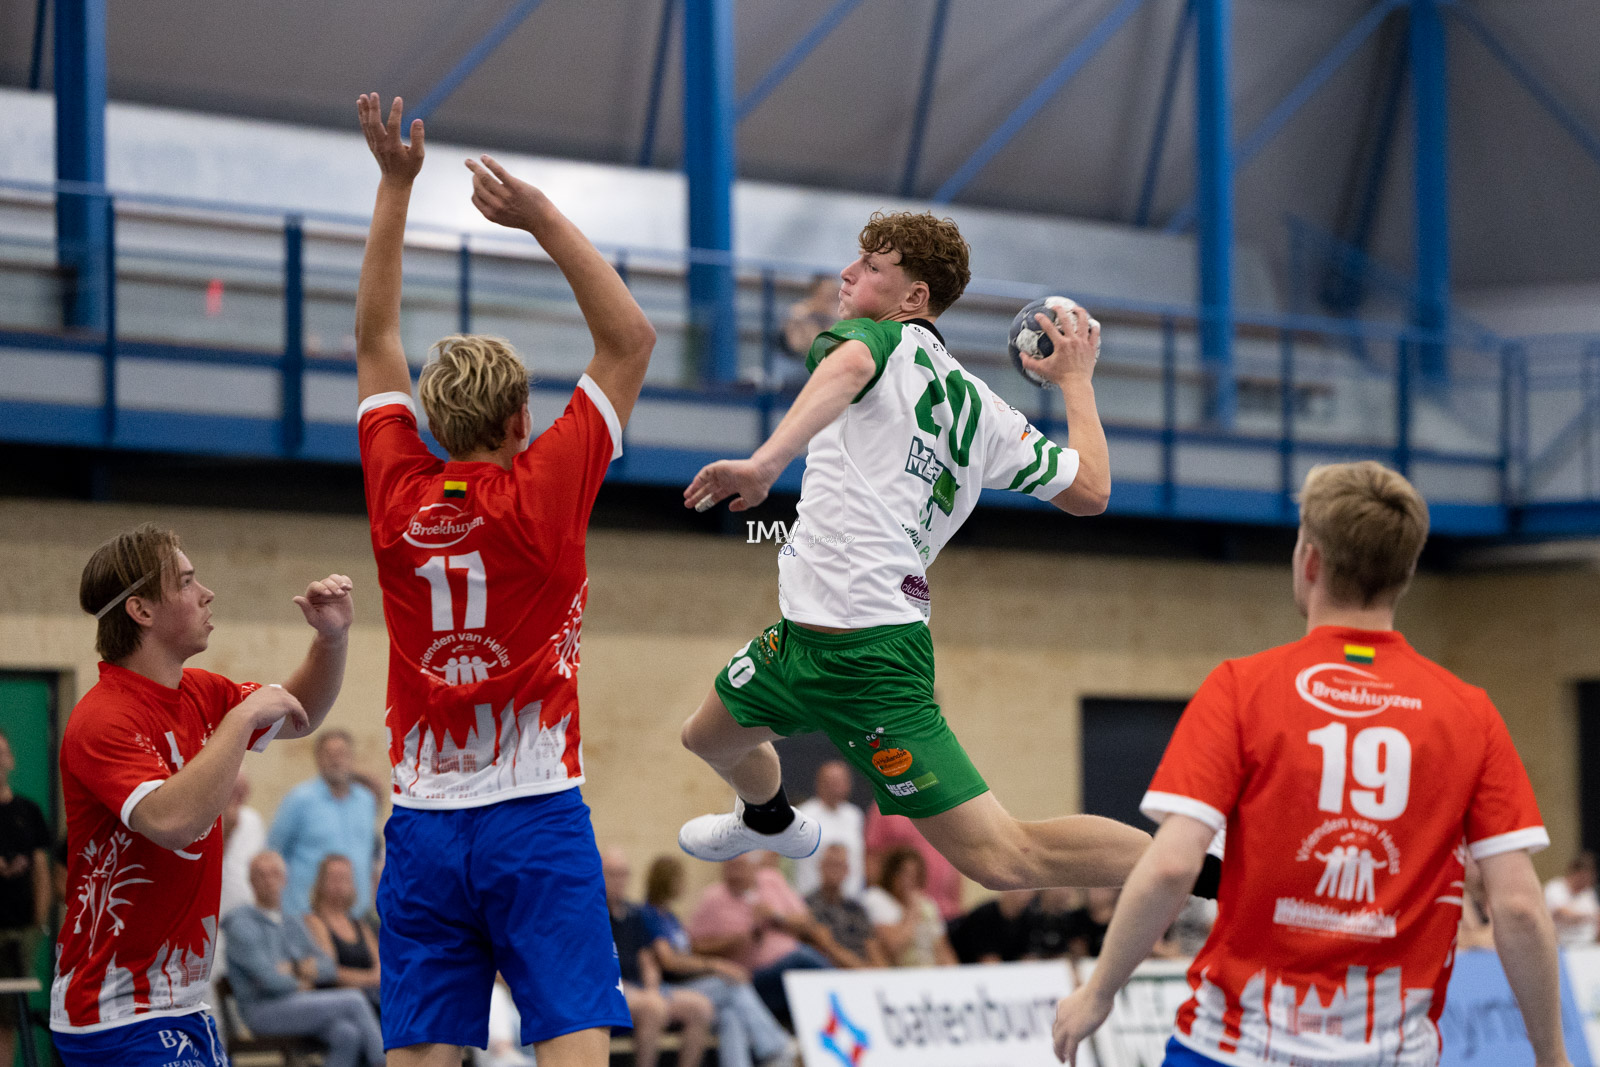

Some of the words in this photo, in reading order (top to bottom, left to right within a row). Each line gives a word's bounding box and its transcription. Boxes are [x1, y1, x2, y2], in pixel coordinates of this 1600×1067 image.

[913, 345, 983, 467] 20
[414, 550, 488, 632] 17
[420, 633, 456, 672] rienden
[458, 632, 482, 644] van
[483, 636, 511, 668] Hellas
[1312, 680, 1423, 711] Broekhuyzen
[1307, 721, 1412, 821] 19
[1350, 818, 1379, 837] van
[873, 986, 1058, 1050] batenbur
